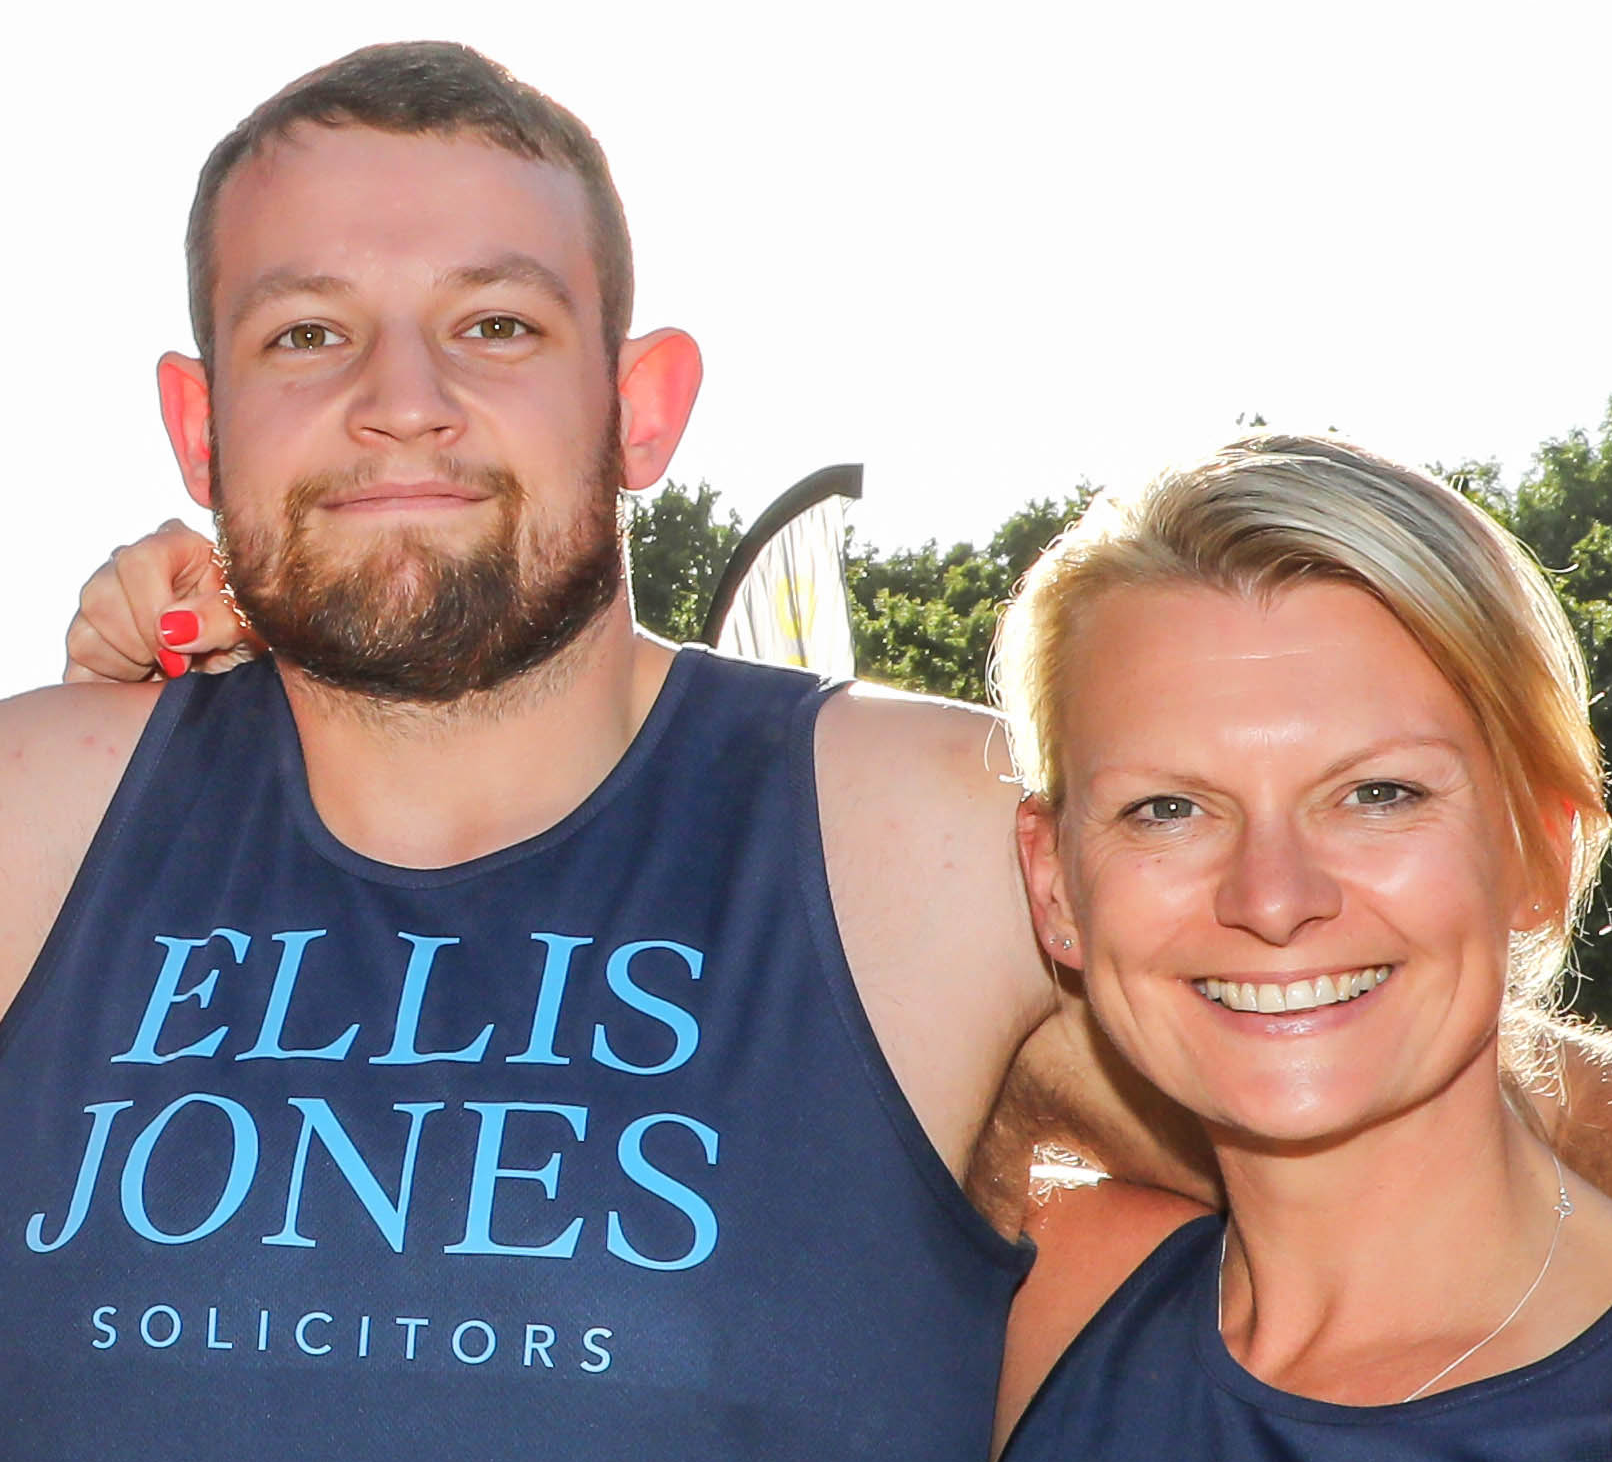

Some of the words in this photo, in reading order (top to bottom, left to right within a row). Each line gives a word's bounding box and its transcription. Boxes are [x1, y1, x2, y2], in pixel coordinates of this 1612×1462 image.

[109, 926, 705, 1076] ELLIS
[24, 1092, 720, 1272] JONES
[91, 1303, 616, 1375] SOLICITORS
